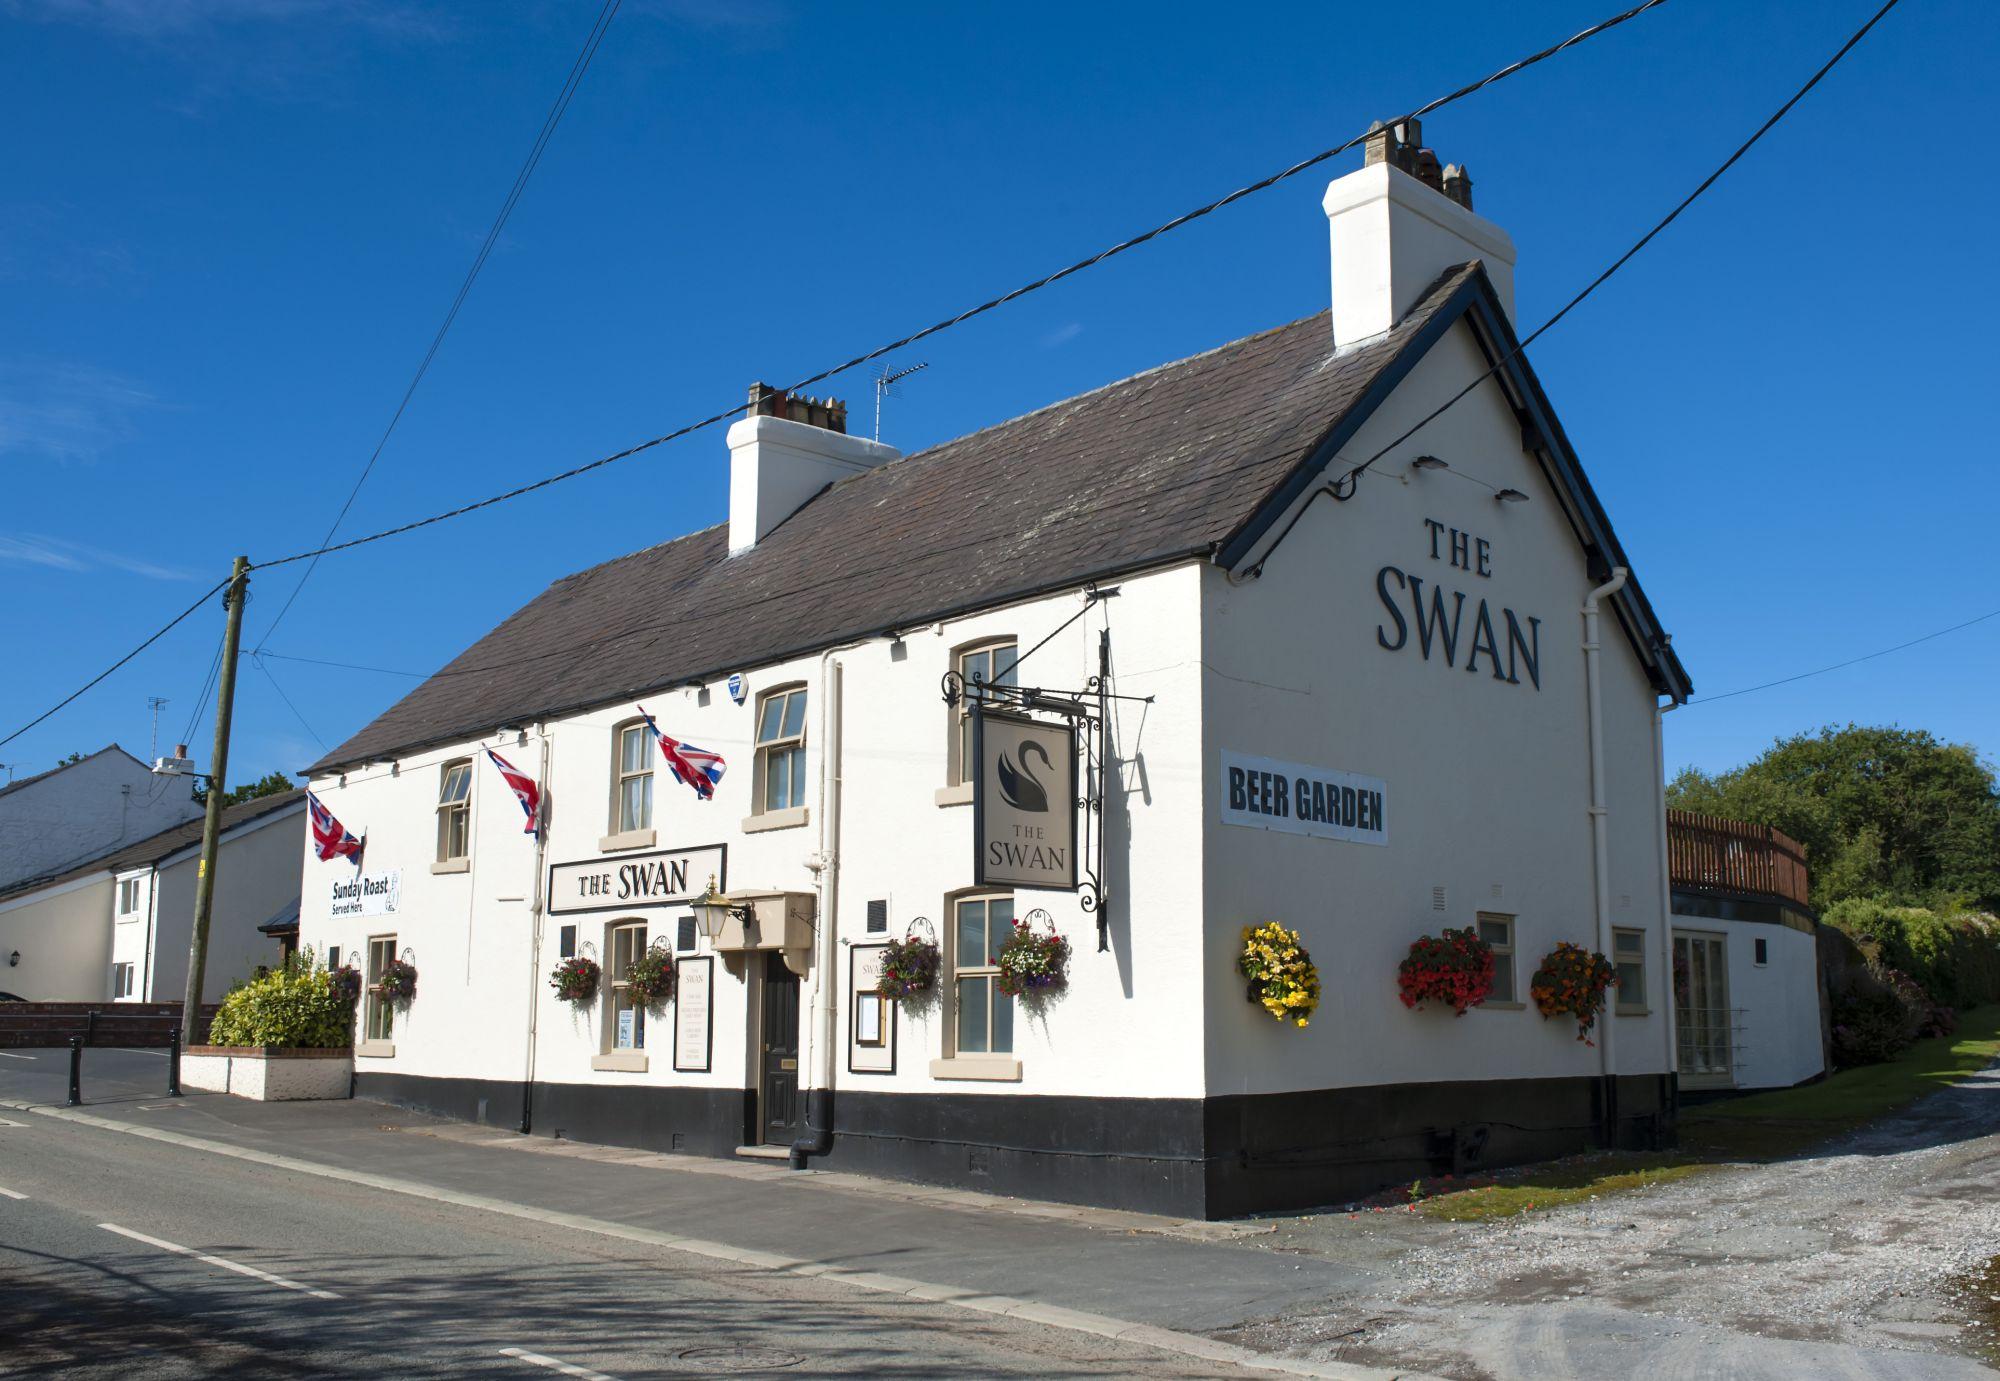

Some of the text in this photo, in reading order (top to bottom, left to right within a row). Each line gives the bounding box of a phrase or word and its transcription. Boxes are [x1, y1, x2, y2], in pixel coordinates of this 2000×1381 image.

[1424, 518, 1491, 578] THE
[1377, 566, 1541, 692] SWAN
[1229, 766, 1382, 832] BEER GARDEN
[1012, 824, 1044, 840] THE
[990, 841, 1065, 871] SWAN
[333, 876, 388, 902] Sunday Roast
[578, 859, 689, 900] THE SWAN
[332, 902, 363, 916] Served Here
[862, 964, 882, 975] SWA
